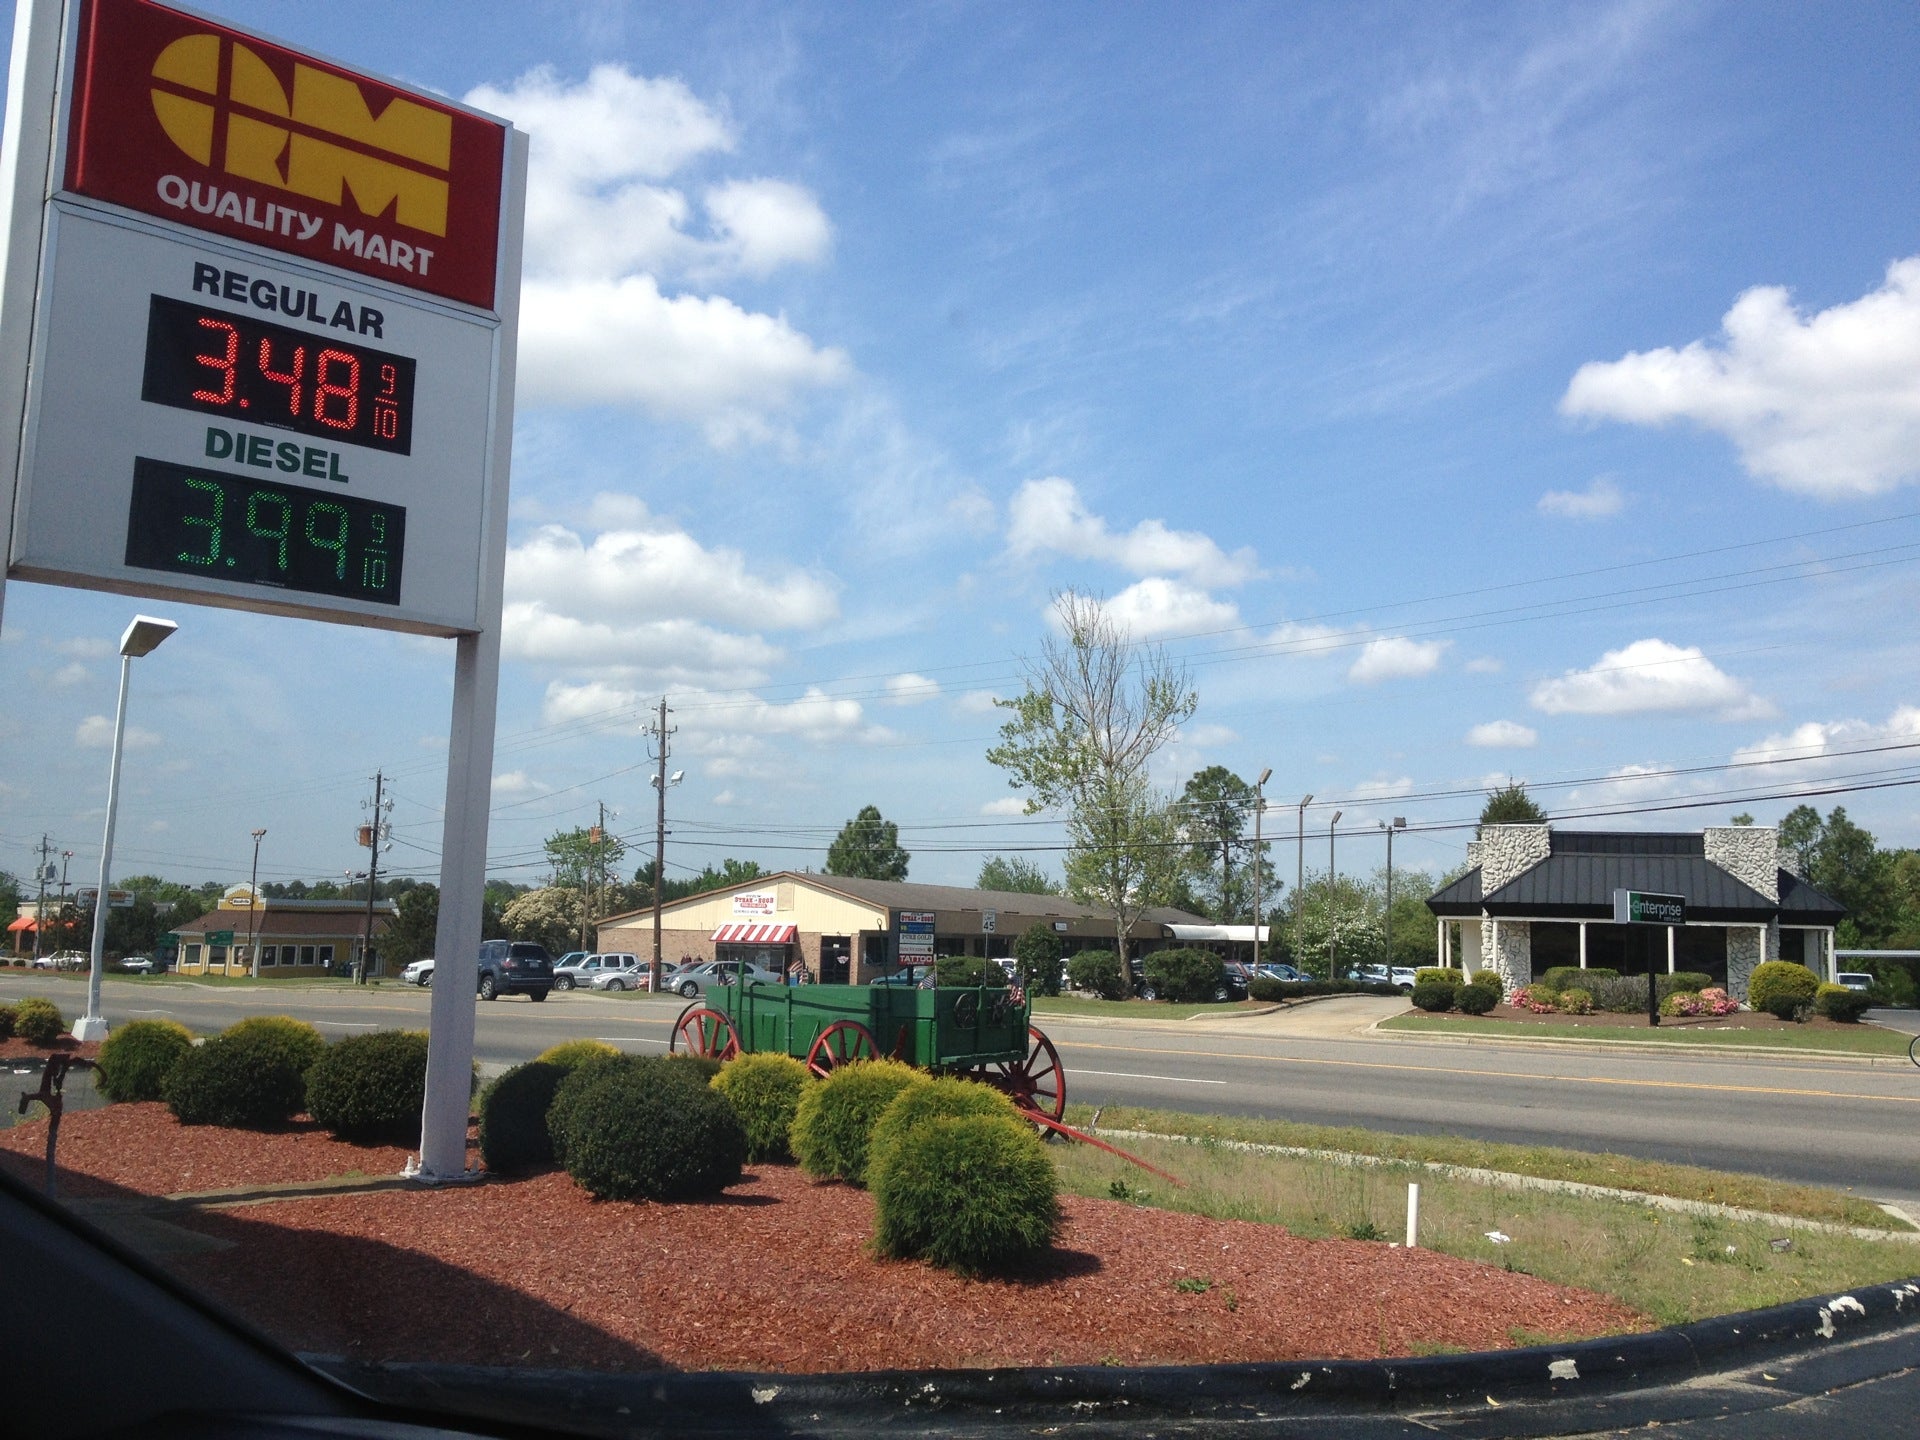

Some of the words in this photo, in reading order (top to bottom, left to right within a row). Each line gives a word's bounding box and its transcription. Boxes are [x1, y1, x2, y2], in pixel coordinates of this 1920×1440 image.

[156, 174, 323, 240] QUALITY
[332, 222, 435, 276] MART
[192, 261, 386, 339] REGULAR
[205, 426, 349, 483] DIESEL
[984, 922, 994, 930] 45
[1631, 900, 1682, 918] enterprise
